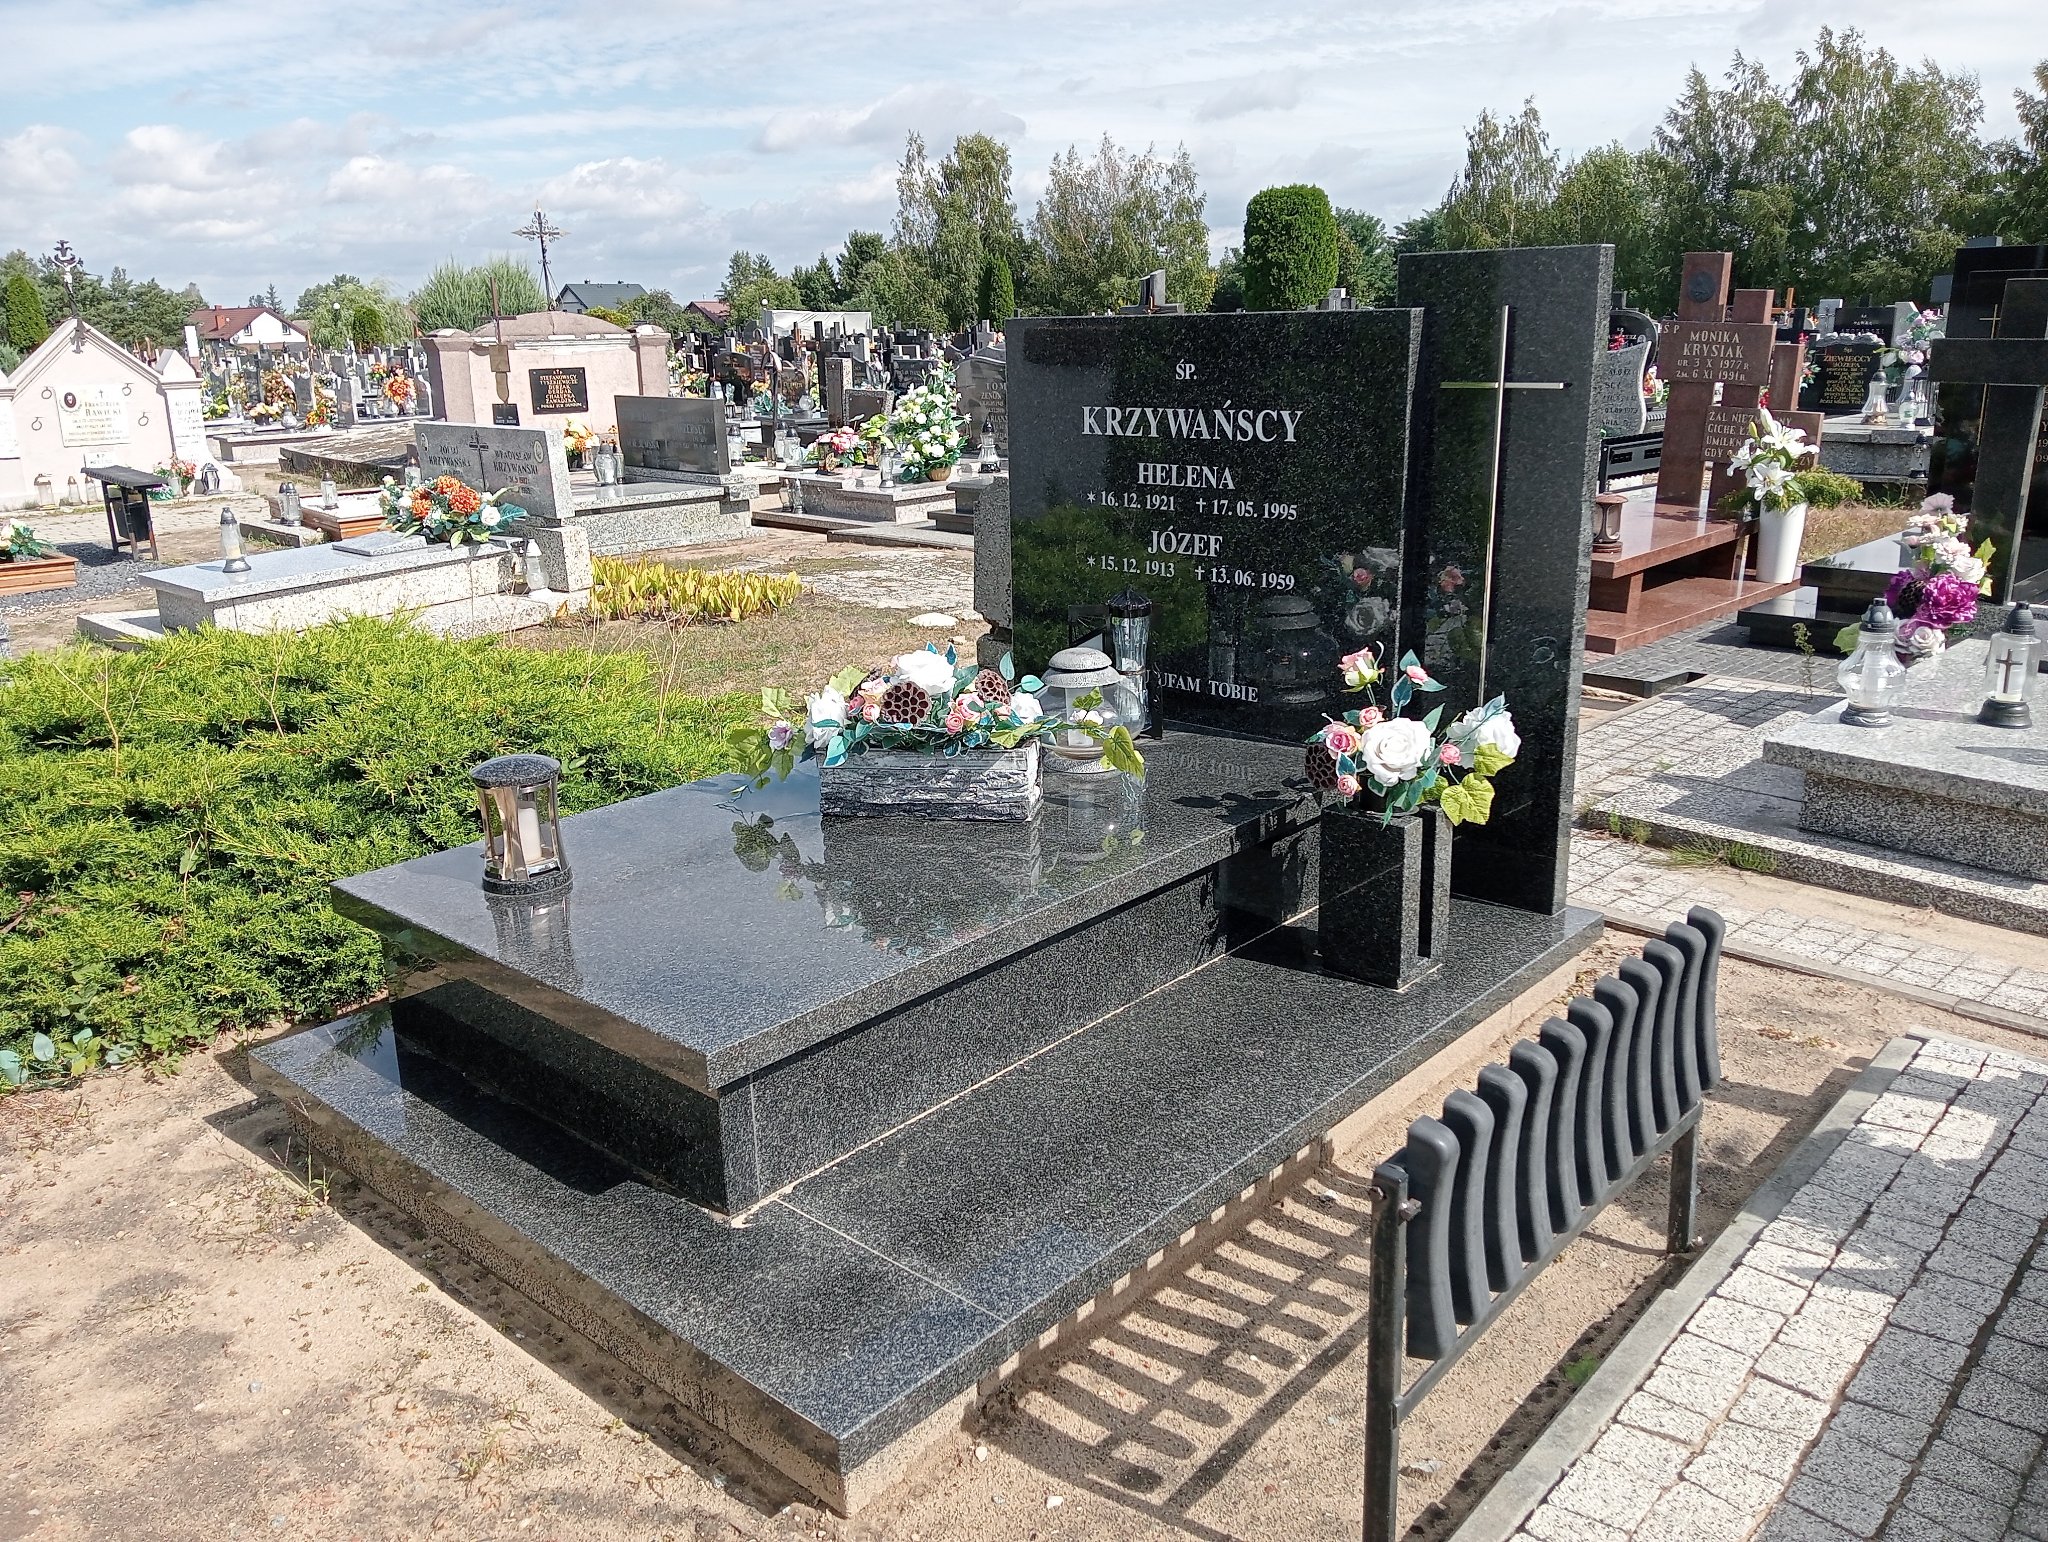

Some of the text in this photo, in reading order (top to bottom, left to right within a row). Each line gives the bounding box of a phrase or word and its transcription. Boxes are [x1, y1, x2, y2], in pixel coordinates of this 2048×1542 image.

[1690, 330, 1740, 344] MONIKA
[1683, 343, 1744, 359] KRYSIAK
[1175, 359, 1198, 380] ŚP.
[1694, 358, 1700, 368] 3
[1706, 358, 1713, 368] X
[1720, 359, 1742, 370] 1977
[1692, 369, 1699, 378] 6
[1703, 369, 1713, 379] XI
[1718, 370, 1740, 381] 1991
[1081, 399, 1303, 442] KRZYWAŃSCY
[1707, 423, 1736, 435] CICHE
[1704, 447, 1724, 458] GDY
[1137, 462, 1236, 490] HELENA
[1145, 494, 1175, 511] 1921
[1263, 502, 1298, 520] 1995
[1147, 525, 1223, 557] JÓZEF
[1144, 560, 1175, 578] 1913
[1260, 572, 1295, 591] 1959
[1208, 680, 1258, 703] TOBIE
